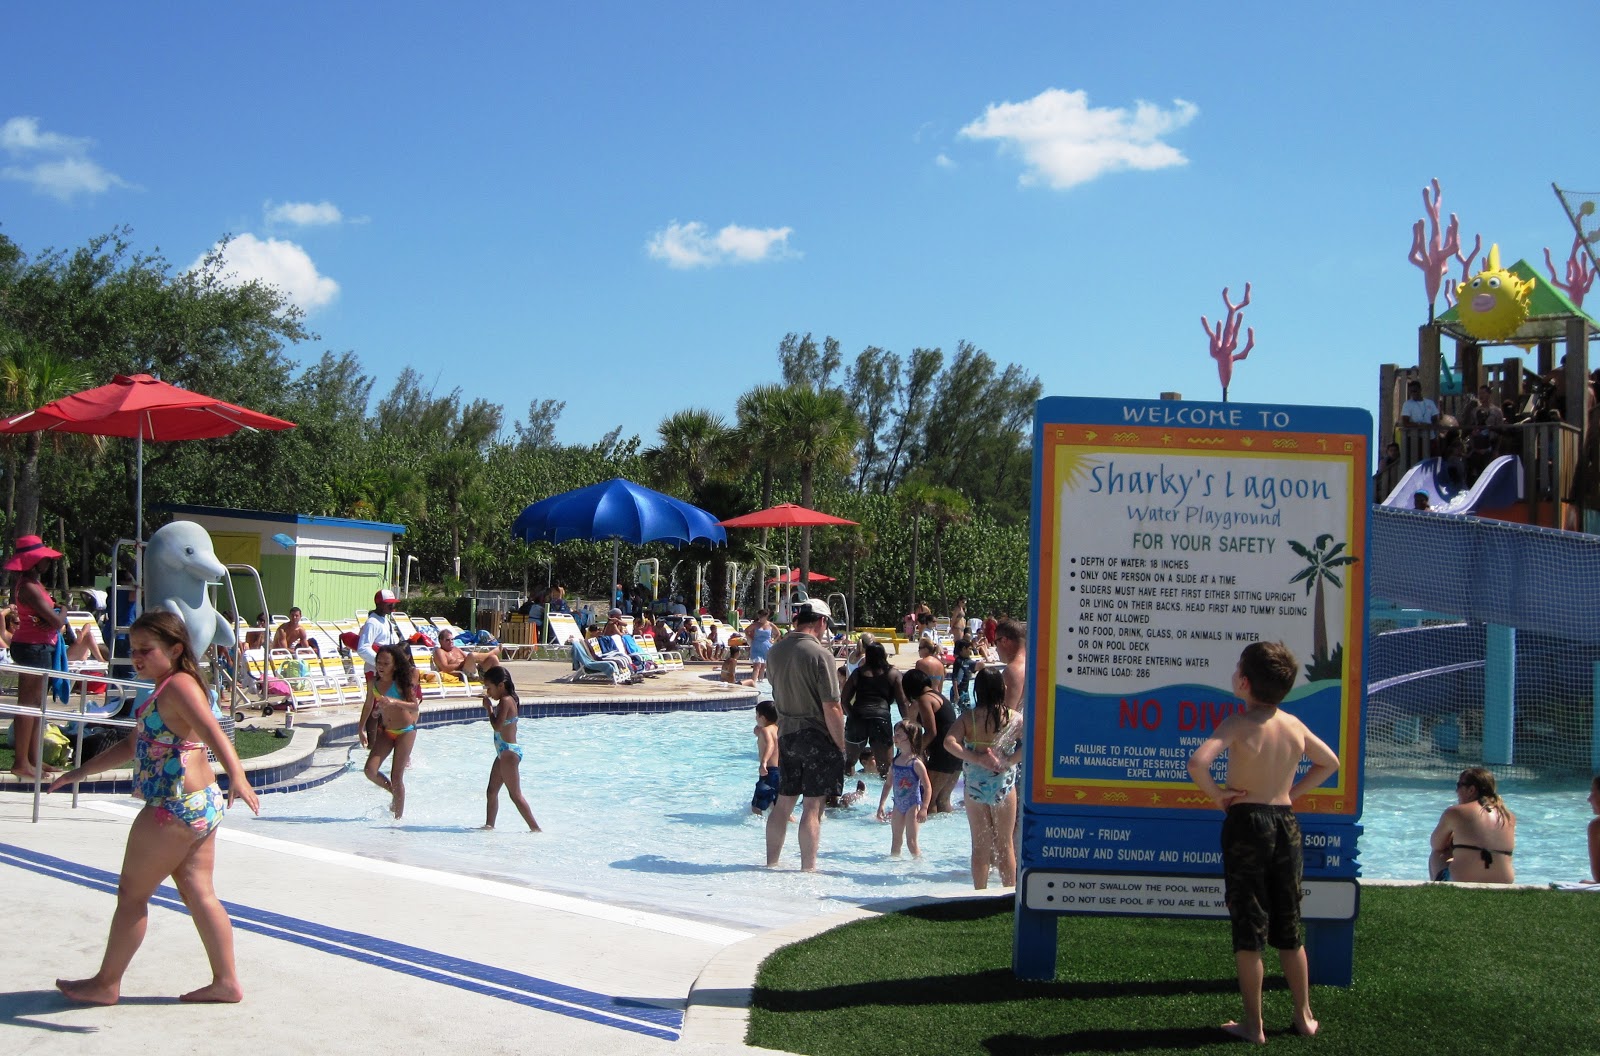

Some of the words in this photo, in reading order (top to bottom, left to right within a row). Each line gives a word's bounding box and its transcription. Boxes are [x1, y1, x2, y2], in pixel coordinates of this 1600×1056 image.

[1123, 406, 1243, 426] WELCOME
[1259, 411, 1290, 428] TO
[1088, 461, 1215, 507] Sharky's
[1226, 471, 1331, 509] Lagoon
[1127, 505, 1180, 523] Water
[1185, 505, 1281, 530] Playground
[1132, 532, 1163, 550] FOR
[1170, 533, 1211, 552] YOUR
[1219, 535, 1276, 554] SAFETY
[1080, 557, 1104, 566] DEPTH
[1108, 557, 1118, 567] OF
[1121, 558, 1147, 568] WATER:
[1150, 559, 1158, 569] 18
[1161, 560, 1189, 569] INCHES
[1080, 571, 1099, 580] ONLY
[1102, 571, 1118, 580] ONE
[1121, 572, 1151, 581] PERSON
[1154, 573, 1165, 582] ON
[1168, 574, 1173, 582] A
[1176, 574, 1197, 583] SLIDE
[1200, 575, 1209, 584] AT
[1211, 576, 1216, 584] A
[1219, 576, 1236, 585] TIME
[1080, 585, 1112, 595] SLIDERS
[1115, 586, 1136, 596] MUST
[1138, 587, 1157, 597] HAVE
[1160, 588, 1178, 597] FEET
[1181, 588, 1202, 598] FIRST
[1205, 590, 1230, 599] EITHER
[1234, 591, 1262, 601] SITTING
[1265, 592, 1297, 602] UPRIGHT
[1080, 599, 1090, 608] OR
[1093, 599, 1114, 609] LYING
[1117, 600, 1128, 609] ON
[1132, 601, 1152, 610] THEIR
[1156, 601, 1183, 611] BACKS.
[1185, 603, 1205, 612] HEAD
[1209, 604, 1229, 613] FIRST
[1232, 605, 1247, 613] AND
[1250, 605, 1276, 615] TUMMY
[1279, 607, 1307, 616] SLIDING
[1079, 613, 1094, 621] ARE
[1097, 613, 1112, 622] NOT
[1115, 614, 1150, 623] ALLOWED
[1078, 626, 1089, 635] NO
[1092, 627, 1116, 637] FOOD,
[1119, 628, 1143, 638] DRINK,
[1146, 629, 1174, 640] GLASS,
[1177, 630, 1188, 638] OR
[1190, 631, 1222, 640] ANIMALS
[1225, 632, 1233, 640] IN
[1236, 632, 1260, 641] WATER
[1078, 640, 1089, 649] OR
[1092, 640, 1103, 649] ON
[1106, 641, 1126, 650] POOL
[1129, 642, 1149, 651] DECK
[1078, 653, 1110, 663] SHOWER
[1113, 655, 1142, 665] BEFORE
[1146, 656, 1182, 666] ENTERING
[1185, 658, 1209, 667] WATER
[1077, 666, 1108, 676] BATHING
[1111, 667, 1132, 677] LOAD:
[1136, 668, 1150, 678] 286
[1119, 698, 1163, 731] NO
[1178, 700, 1246, 732] DIV
[1074, 744, 1107, 755] FAILURE
[1110, 745, 1120, 755] TO
[1123, 746, 1157, 757] FOLLOW
[1159, 748, 1185, 758] RULES
[1060, 755, 1080, 765] PARK
[1084, 756, 1140, 768] MANAGEMENT
[1143, 759, 1186, 770] RESERVES
[1209, 762, 1228, 771] RIGH
[1127, 768, 1152, 778] EXPEL
[1155, 769, 1188, 779] ANYONE
[1213, 772, 1228, 781] JUS
[1045, 827, 1085, 839] MONDAY
[1098, 829, 1131, 841] FRIDAY
[1305, 834, 1326, 847] 5:00
[1328, 836, 1341, 847] PM
[1042, 846, 1090, 859] SATURDAY
[1093, 848, 1113, 860] AND
[1117, 849, 1156, 861] SUNDAY
[1159, 851, 1179, 862] AND
[1183, 851, 1224, 864] HOLIDAY
[1327, 855, 1340, 867] PM
[1063, 881, 1076, 889] DO
[1079, 882, 1096, 890] NOT
[1100, 883, 1142, 891] SWALLOW
[1146, 884, 1162, 892] THE
[1165, 885, 1189, 893] POOL
[1192, 885, 1222, 894] WATER,
[1062, 895, 1075, 903] DO
[1078, 896, 1096, 904] NOT
[1120, 897, 1144, 905] POOL
[1158, 898, 1175, 906] YOU
[1178, 899, 1195, 907] ARE
